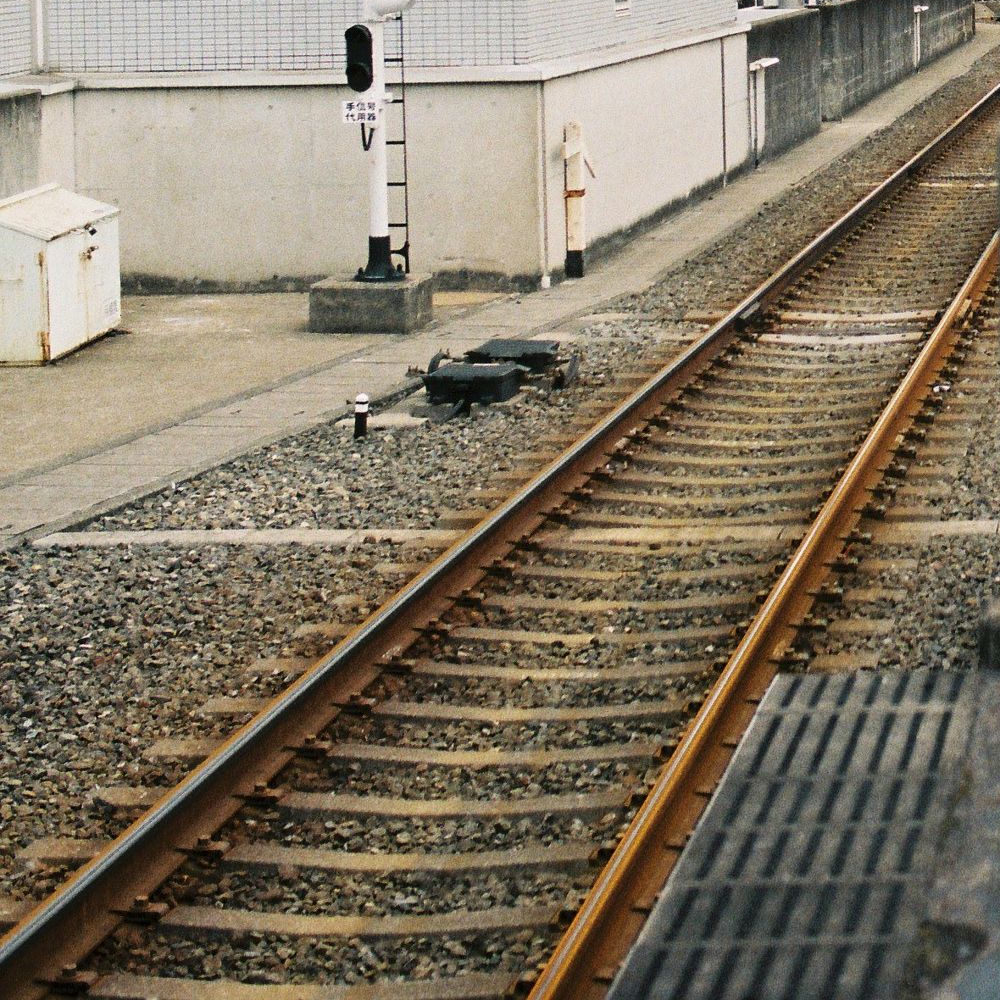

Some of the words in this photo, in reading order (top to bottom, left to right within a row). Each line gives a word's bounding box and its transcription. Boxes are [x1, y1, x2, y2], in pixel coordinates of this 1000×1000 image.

[345, 102, 376, 111] 手信号
[345, 112, 377, 122] 代用器
